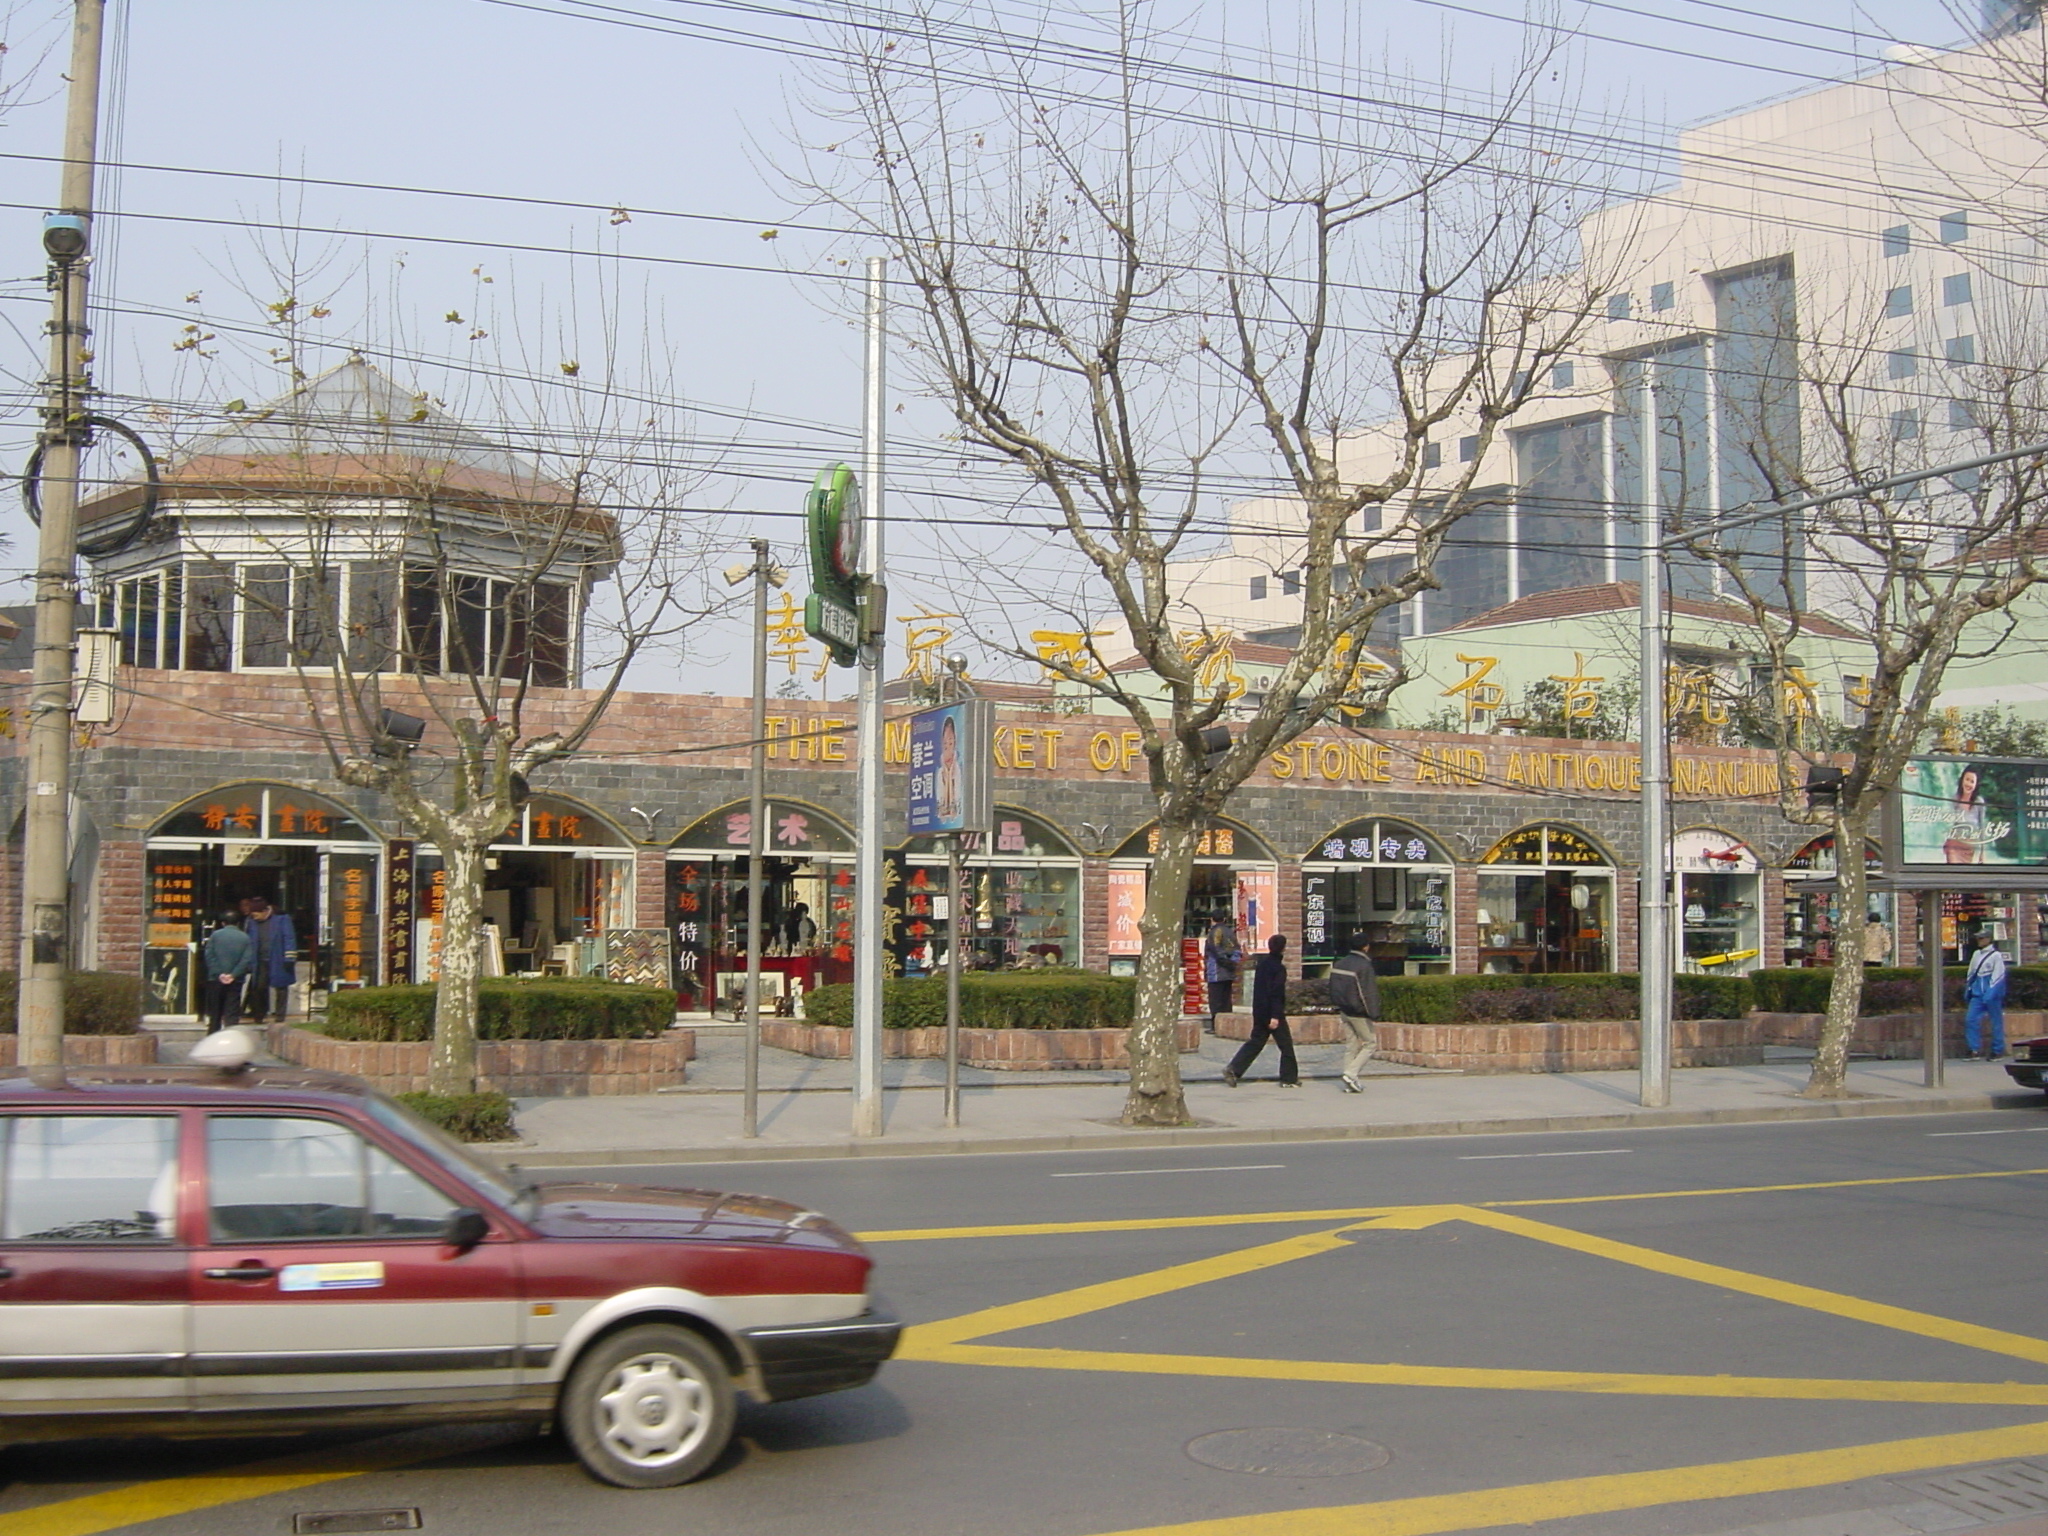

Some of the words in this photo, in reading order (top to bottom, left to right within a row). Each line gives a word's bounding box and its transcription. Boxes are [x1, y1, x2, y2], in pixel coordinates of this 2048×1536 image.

[764, 716, 847, 762] THE
[883, 721, 1064, 770] MKET
[1090, 731, 1142, 773] OF
[1270, 740, 1394, 784] STONE
[1416, 747, 1487, 786] AND
[725, 812, 809, 846] 艺术
[677, 865, 700, 973] 全场特价
[1306, 877, 1326, 943] 广东端砚
